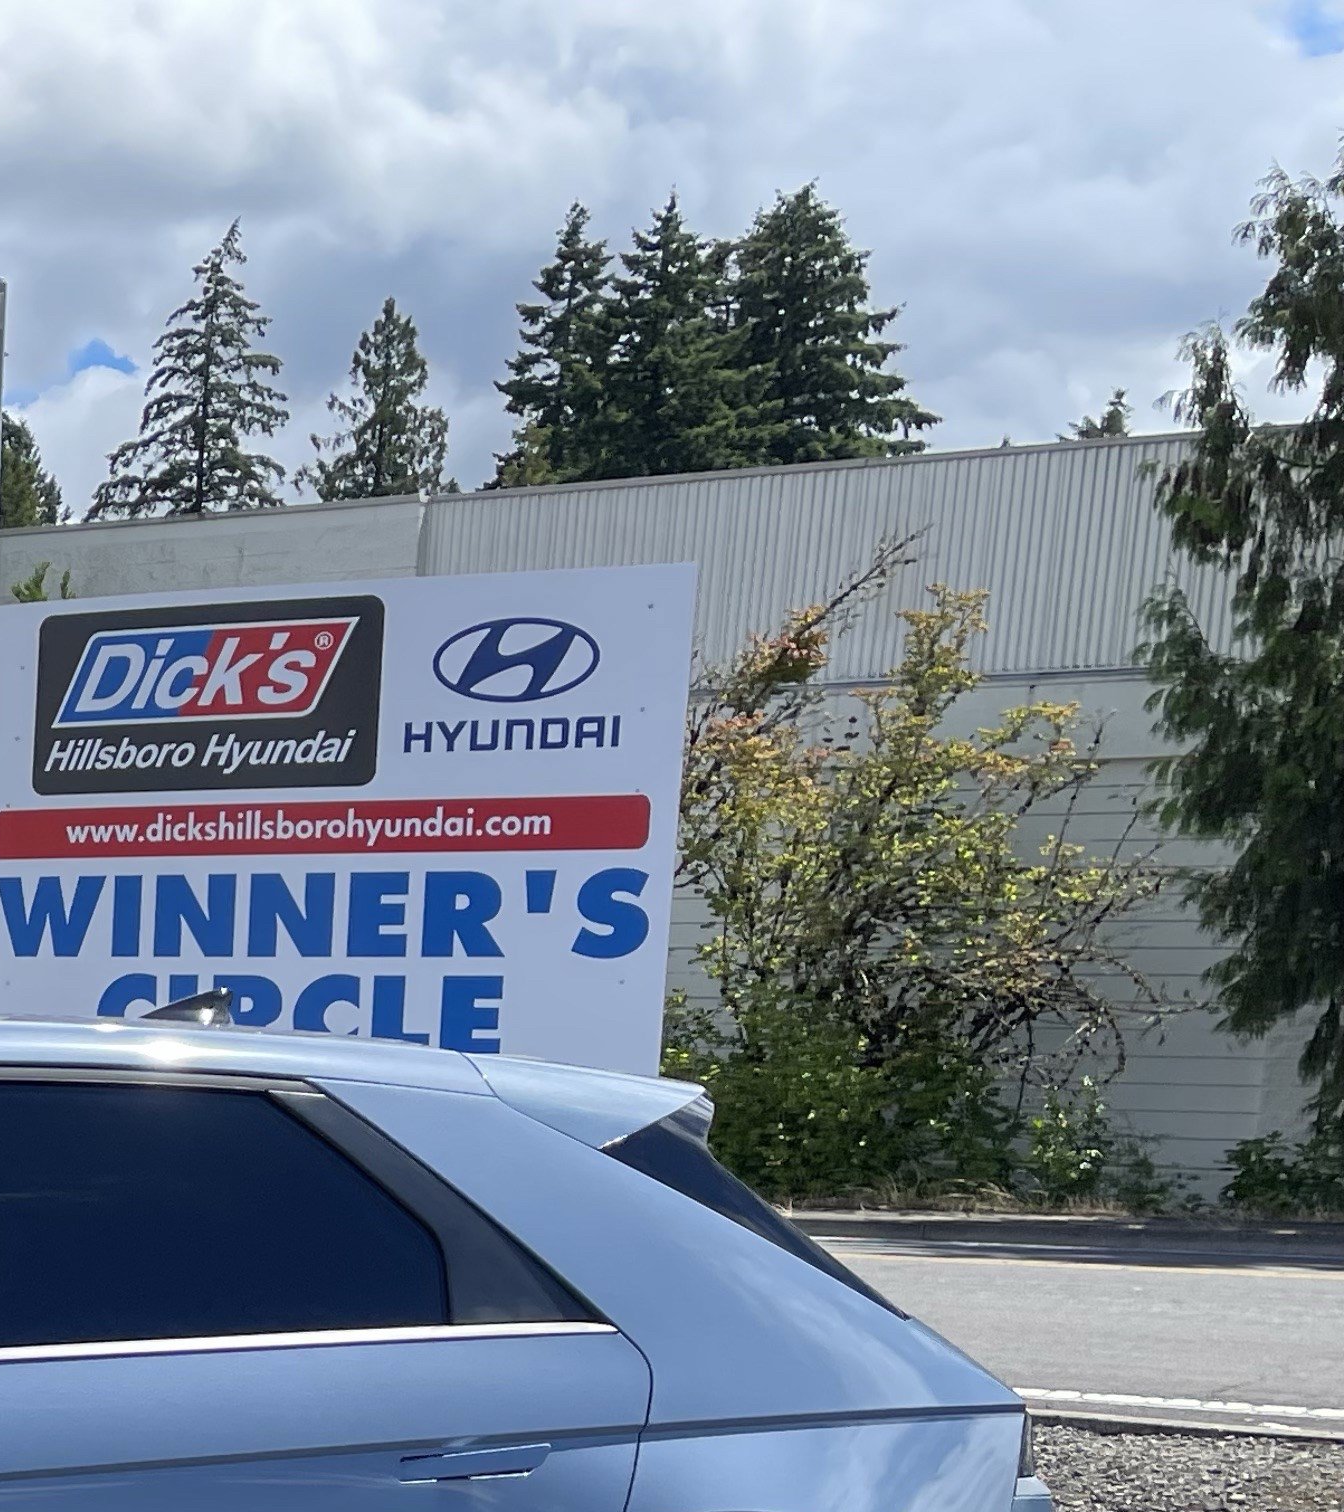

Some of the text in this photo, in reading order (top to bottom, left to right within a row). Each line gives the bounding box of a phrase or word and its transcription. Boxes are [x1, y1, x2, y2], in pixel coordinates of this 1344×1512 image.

[44, 729, 357, 775] Hillsboro Hyundai
[403, 715, 621, 753] HYUNDAI
[66, 806, 552, 846] www.dickshillsborohyundai.com
